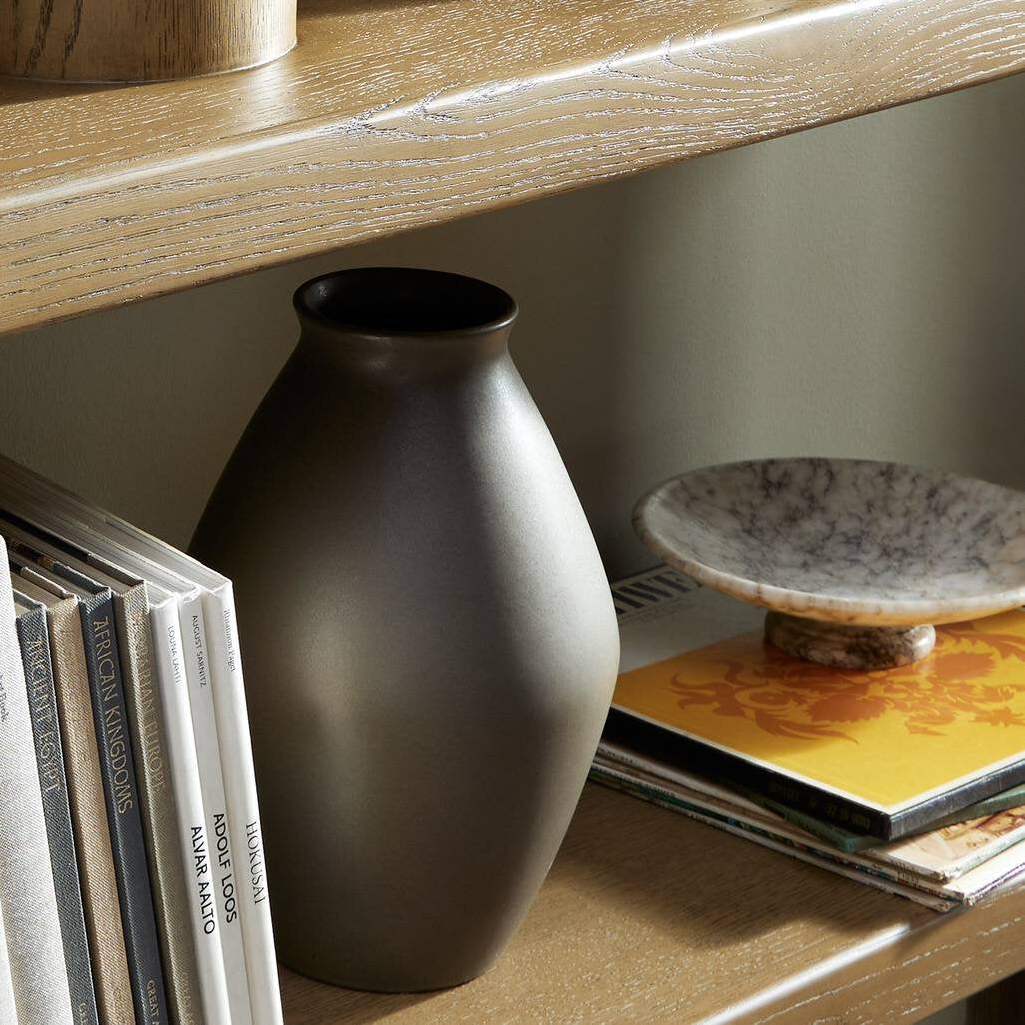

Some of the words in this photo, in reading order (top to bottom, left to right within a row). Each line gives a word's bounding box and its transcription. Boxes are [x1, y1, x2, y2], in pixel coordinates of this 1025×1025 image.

[93, 616, 118, 702] AFRICAN
[192, 614, 203, 651] AUGUST
[196, 651, 207, 688] SARNITZ
[28, 638, 52, 722] ANCIENT
[40, 730, 62, 793] EGYPT
[105, 705, 133, 814] KINGDOMS
[190, 826, 208, 877] ALVAR
[213, 813, 230, 869] ADOLF
[246, 821, 266, 906] HOKUSAI
[197, 881, 215, 935] AALTO
[221, 873, 237, 923] LOOS
[147, 979, 160, 1020] GREAT
